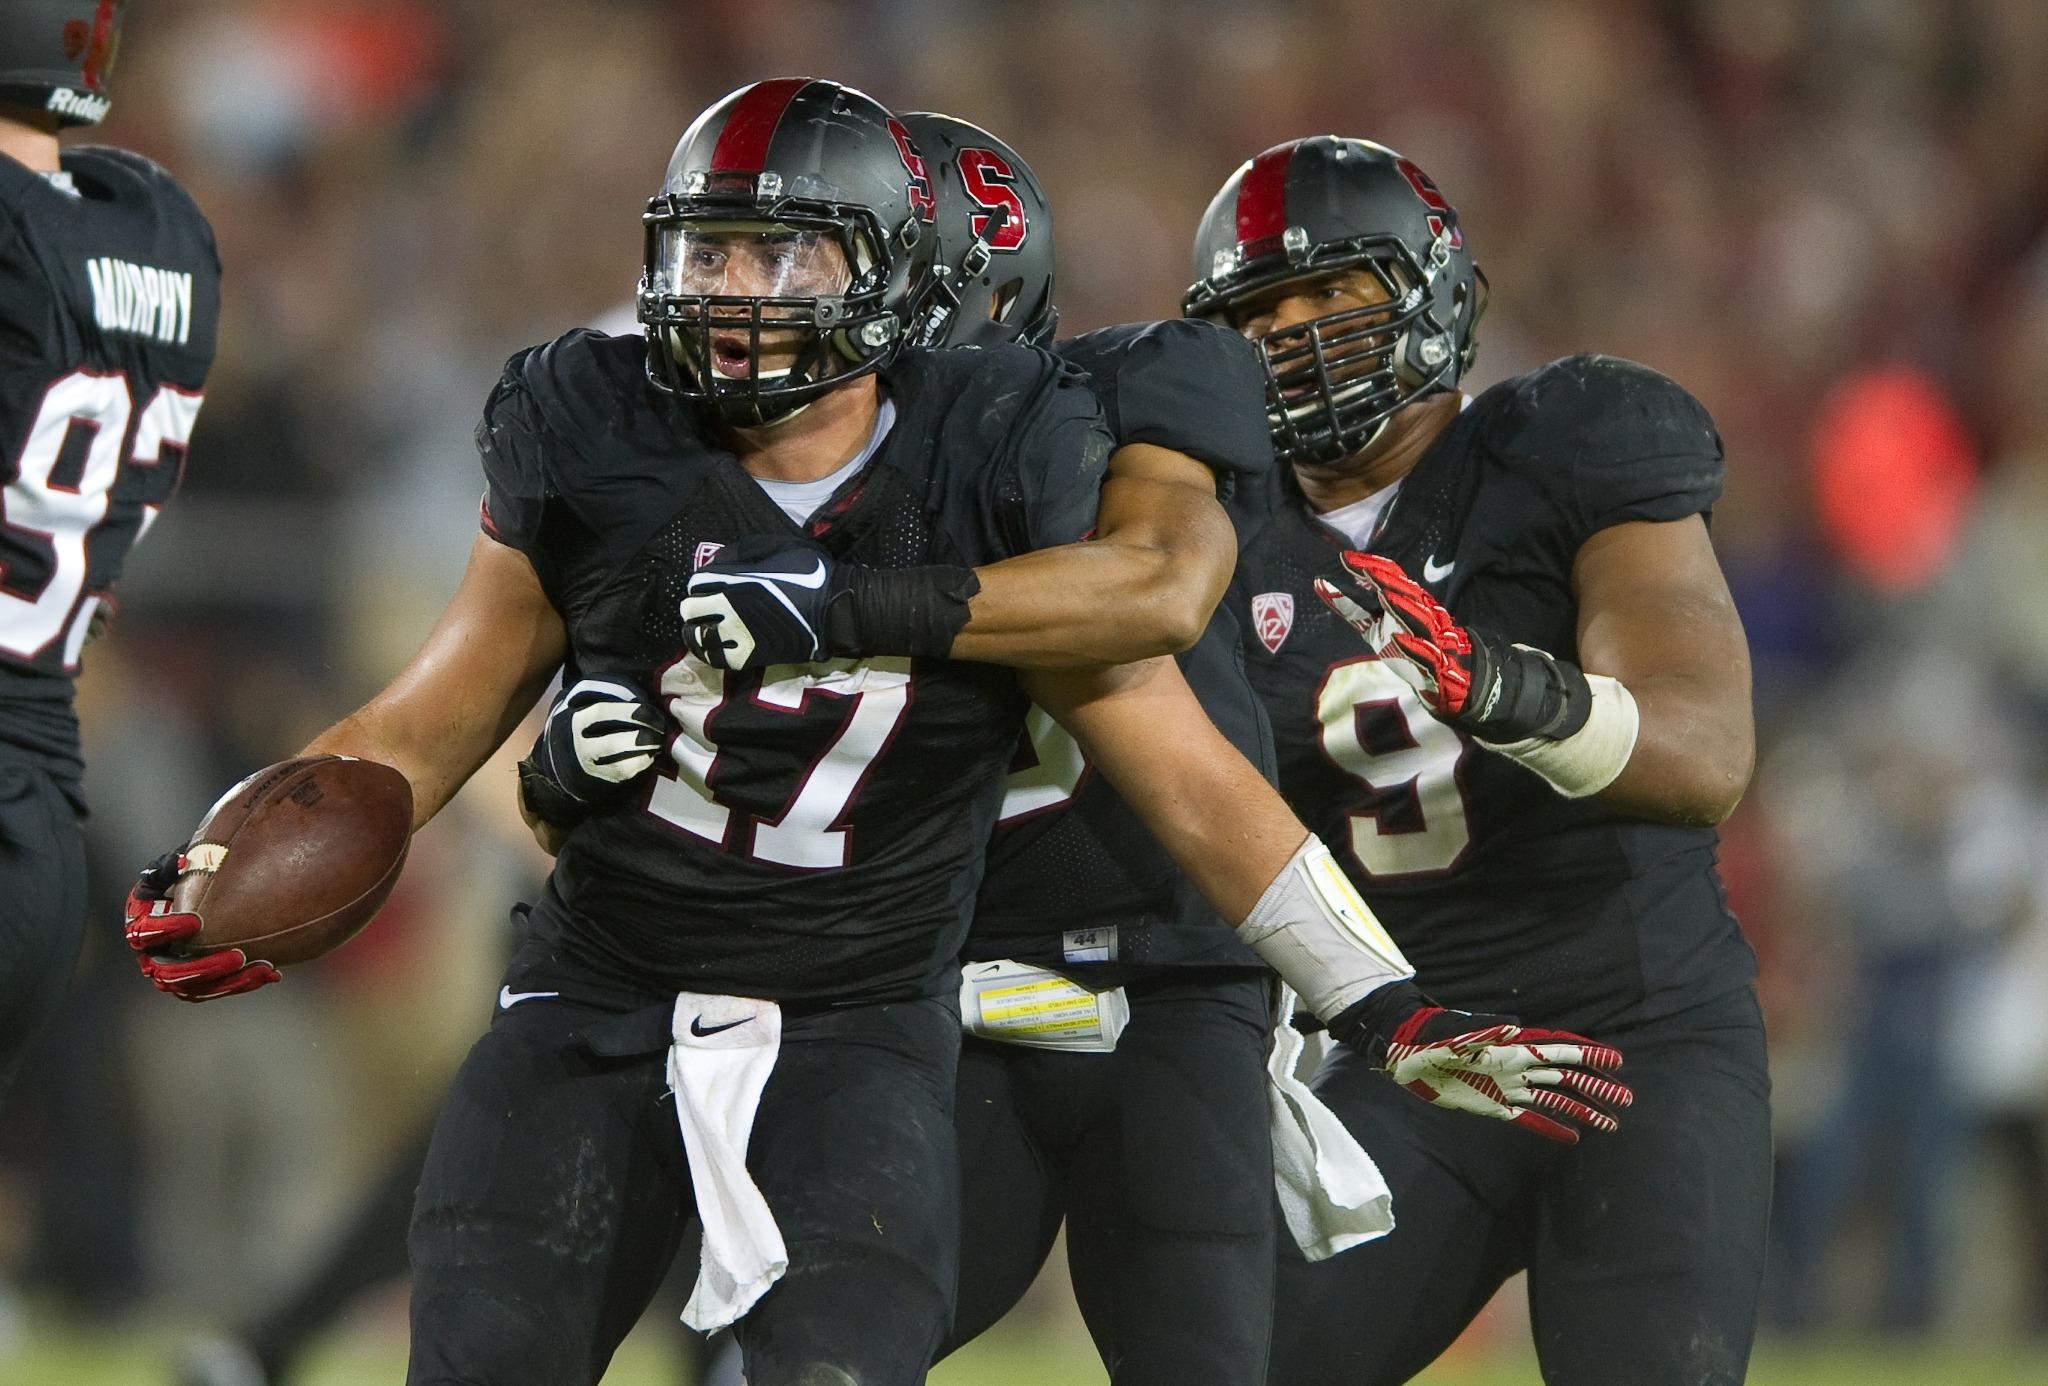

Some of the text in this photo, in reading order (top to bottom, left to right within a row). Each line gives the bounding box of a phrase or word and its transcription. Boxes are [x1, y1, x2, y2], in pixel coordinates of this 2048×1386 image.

[955, 146, 1029, 252] S
[87, 256, 192, 344] MURPHY
[1252, 594, 1293, 630] PAC
[1262, 617, 1284, 640] 12
[643, 650, 915, 870] 17
[1315, 654, 1473, 879] 9
[1073, 931, 1098, 946] 44
